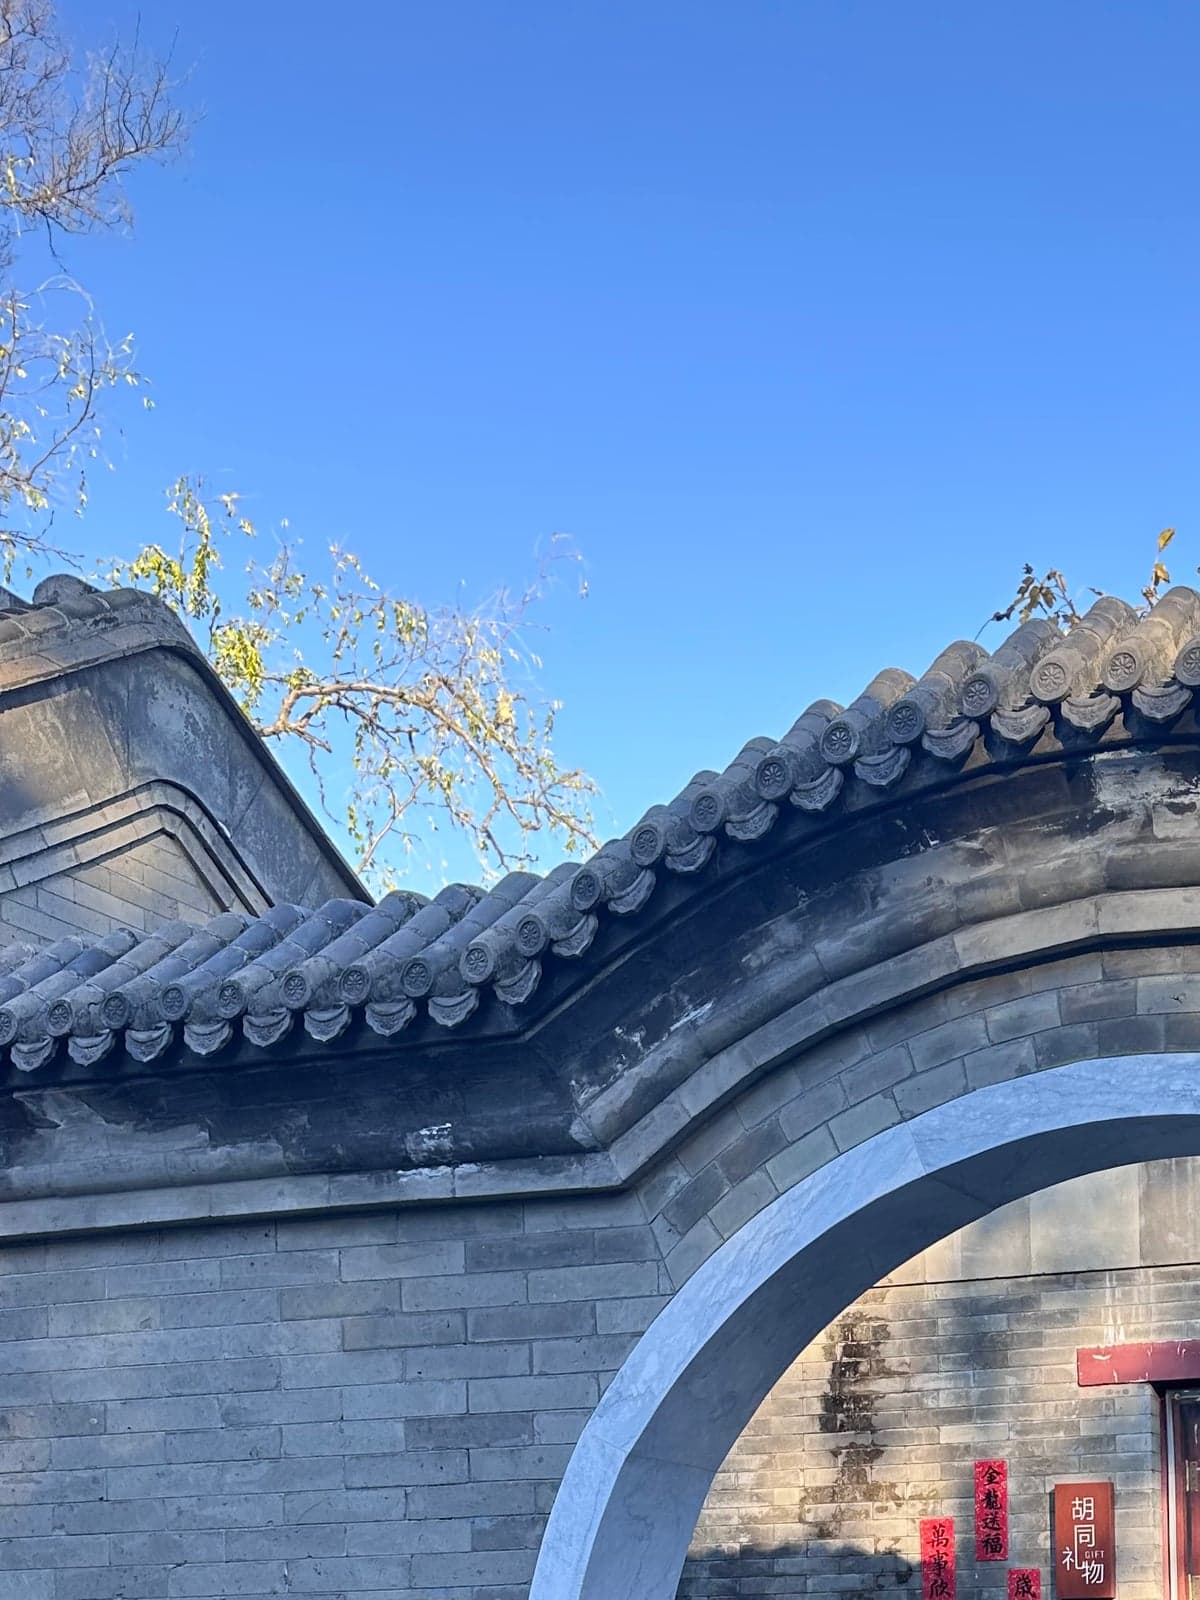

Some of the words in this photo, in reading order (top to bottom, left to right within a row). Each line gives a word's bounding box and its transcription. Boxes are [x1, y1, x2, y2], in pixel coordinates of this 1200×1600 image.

[980, 1465, 1004, 1555] 金龍送福
[926, 1525, 952, 1598] 萬事欣
[1085, 1550, 1105, 1560] GIFT
